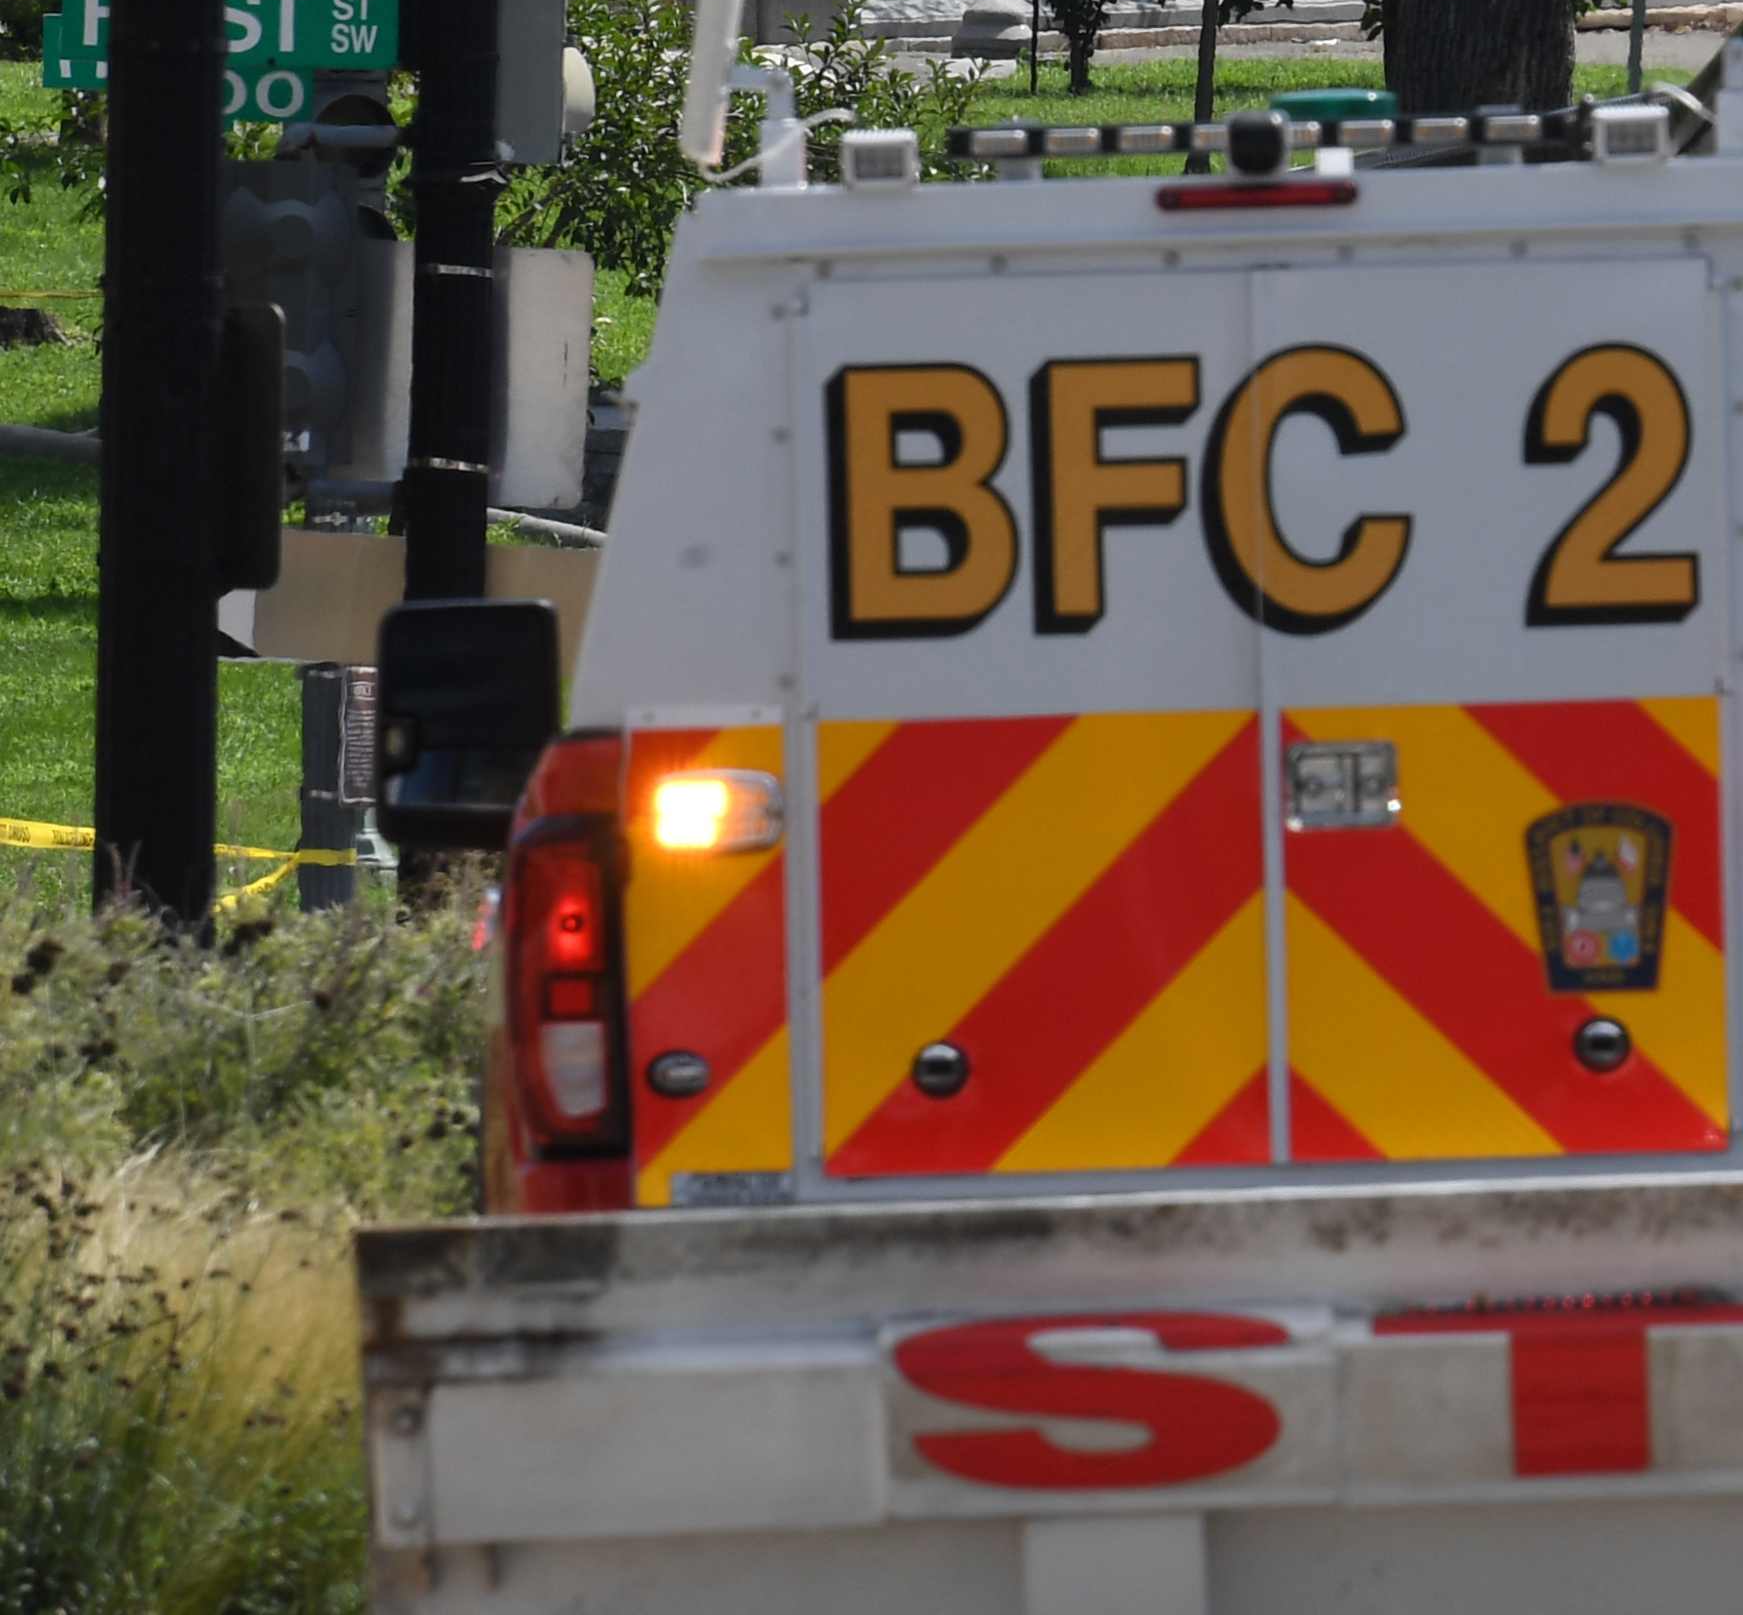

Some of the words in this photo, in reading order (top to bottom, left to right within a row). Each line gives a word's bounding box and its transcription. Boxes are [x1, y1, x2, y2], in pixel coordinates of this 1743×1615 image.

[330, 24, 378, 54] SW
[825, 341, 1414, 640] BFC
[1524, 341, 1700, 627] 2
